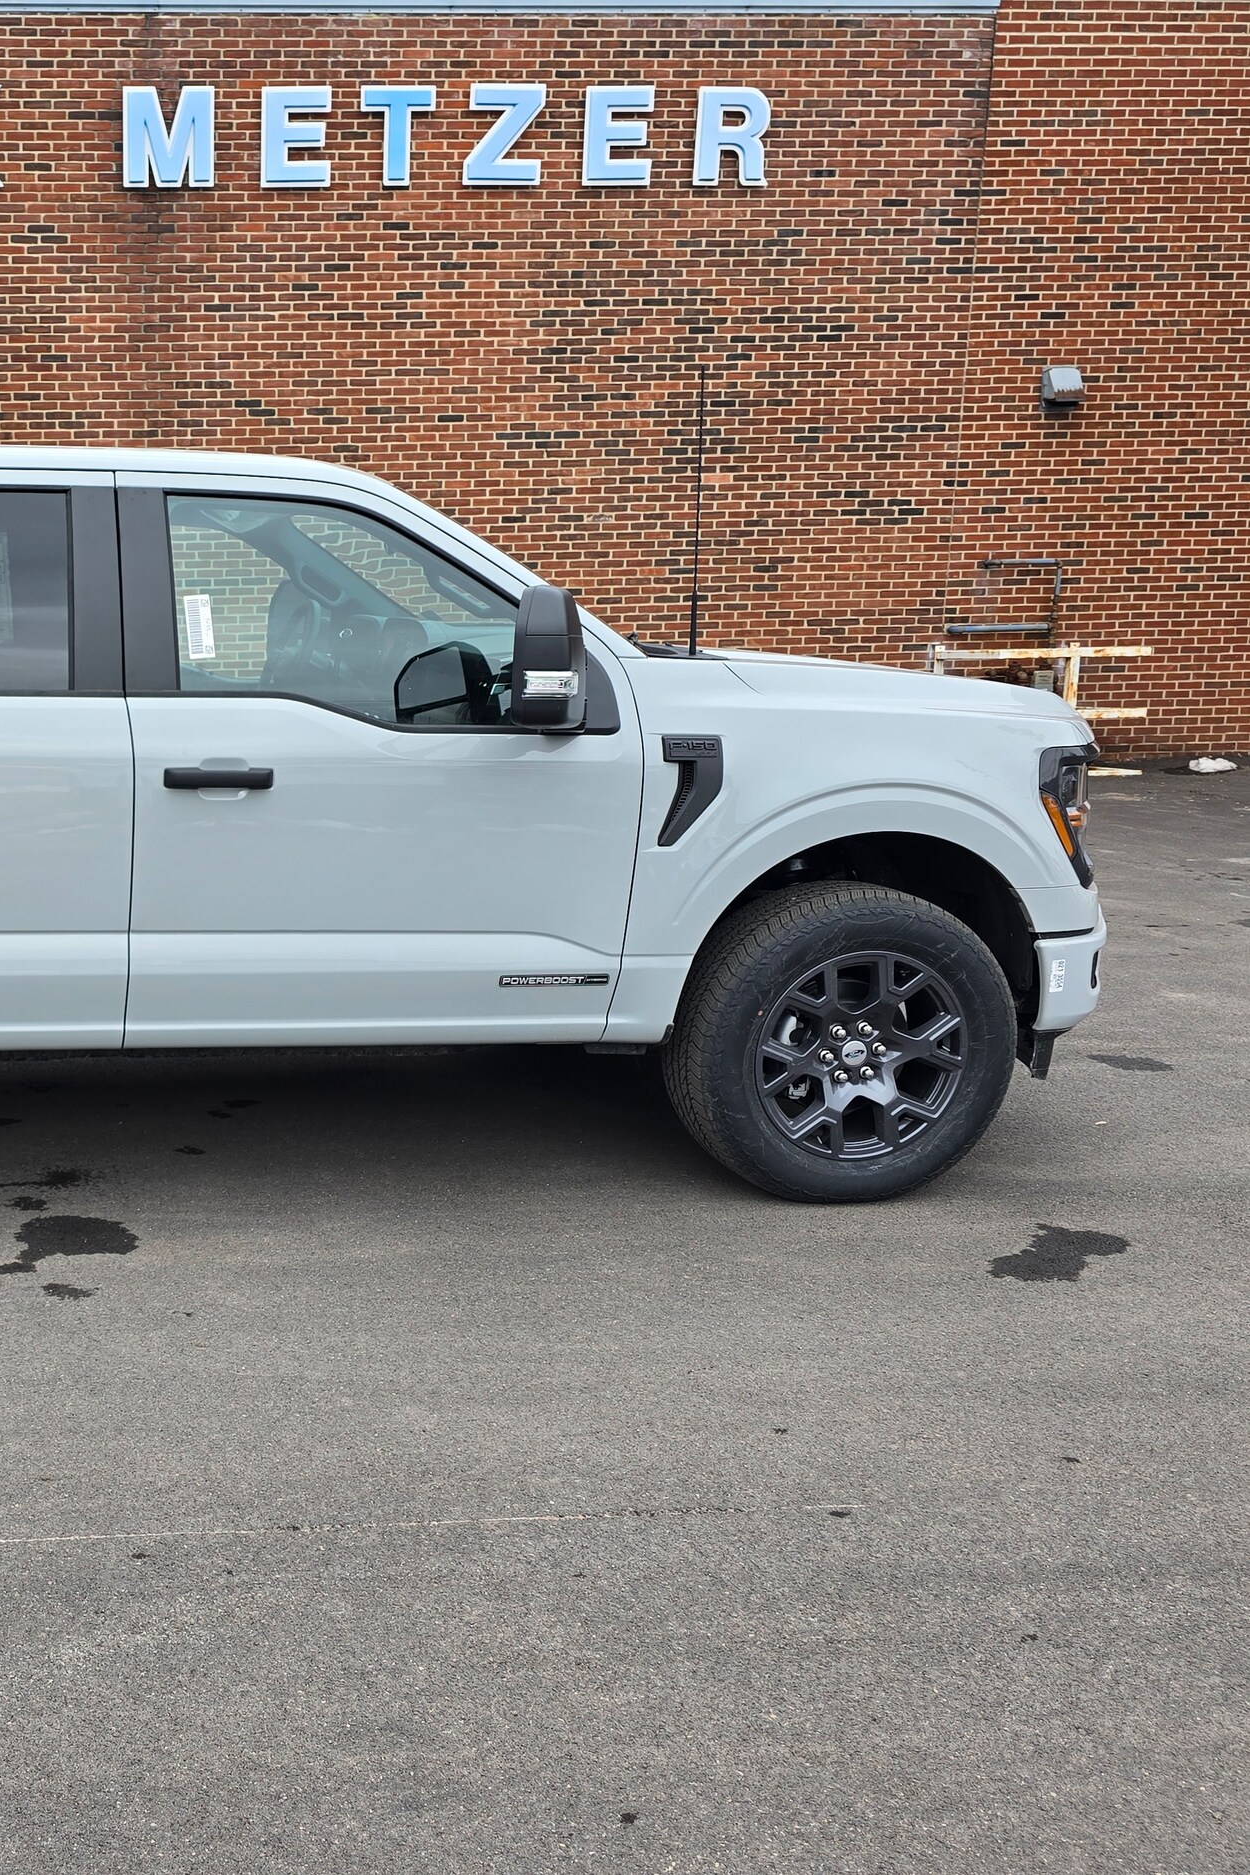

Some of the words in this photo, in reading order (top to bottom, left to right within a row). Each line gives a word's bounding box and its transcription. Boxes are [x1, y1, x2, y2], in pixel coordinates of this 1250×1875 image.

[122, 83, 771, 188] METZER
[669, 740, 717, 751] F-150
[502, 976, 585, 985] POWERBOOST
